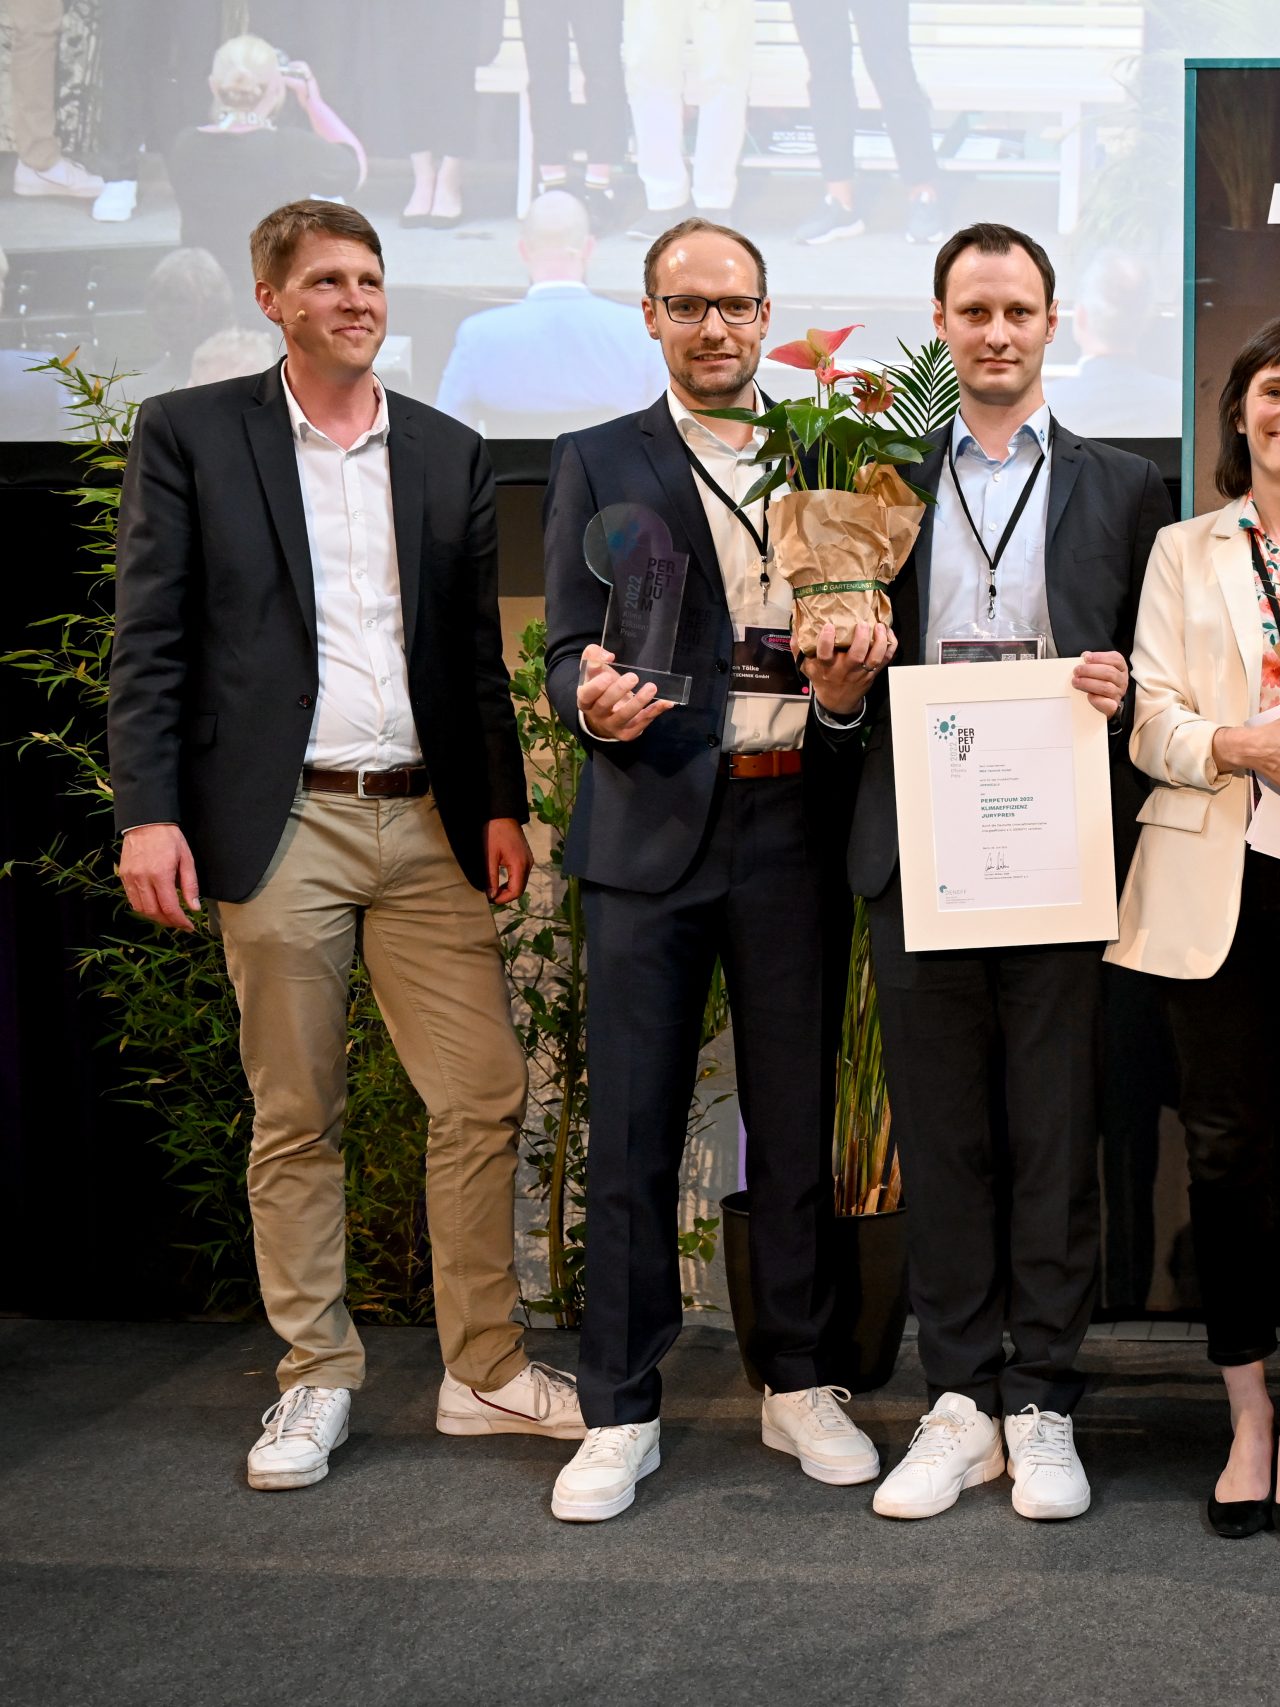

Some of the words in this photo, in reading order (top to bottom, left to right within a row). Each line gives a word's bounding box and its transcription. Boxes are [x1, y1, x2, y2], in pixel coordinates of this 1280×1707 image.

[829, 582, 873, 591] GARTENKUNST
[625, 575, 643, 609] 2022
[958, 728, 975, 737] PER
[958, 736, 974, 745] PET
[959, 744, 971, 753] UU
[959, 753, 967, 761] M
[981, 804, 1028, 812] KLIMAEFFIZIENZ
